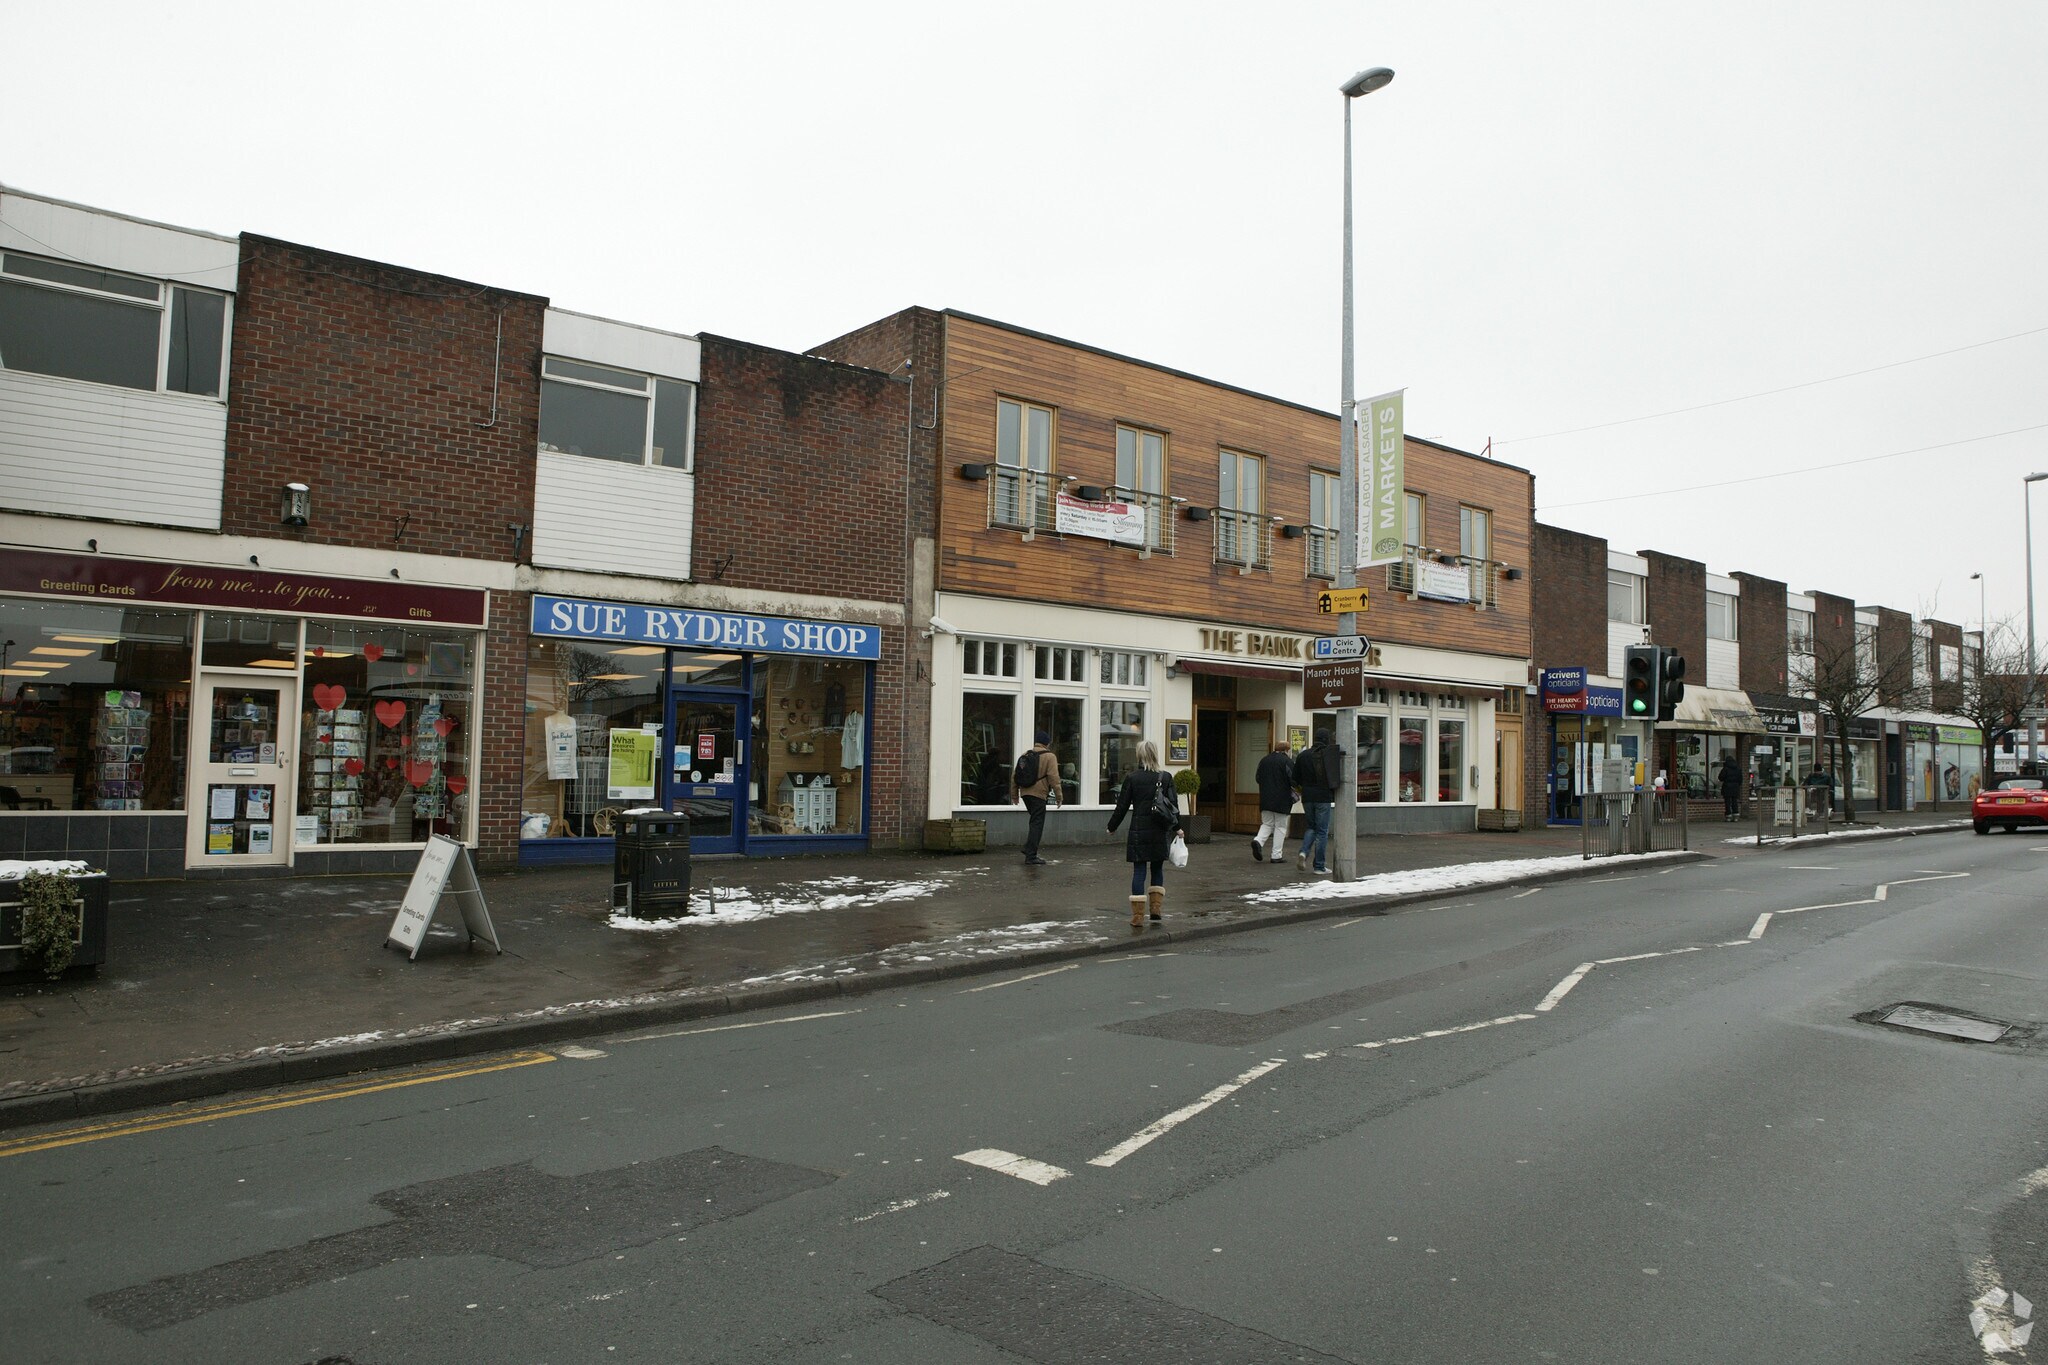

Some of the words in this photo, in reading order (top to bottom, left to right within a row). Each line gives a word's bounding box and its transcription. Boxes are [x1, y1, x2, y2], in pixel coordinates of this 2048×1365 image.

[1361, 407, 1371, 463] ALSAGER
[1380, 406, 1396, 529] MARKETS
[1363, 467, 1371, 508] ABOUT
[1362, 512, 1371, 533] ALL
[1361, 536, 1370, 559] IT'S
[40, 578, 96, 595] Greeting
[100, 583, 136, 596] Cards
[151, 567, 214, 594] from
[409, 607, 433, 618] Gifts
[551, 601, 627, 636] SUE
[643, 609, 769, 648] RYDER
[782, 622, 868, 654] SHOP
[1198, 628, 1243, 653] THE
[1246, 632, 1303, 659] BANK
[1332, 647, 1357, 655] Centre
[1336, 639, 1354, 647] Civic
[1306, 667, 1332, 679] Manor
[1334, 666, 1360, 676] House
[1547, 670, 1581, 680] scrivens
[1321, 677, 1345, 688] Hotel
[1547, 679, 1581, 688] opticians
[1589, 694, 1620, 709] opticians
[612, 735, 635, 745] What
